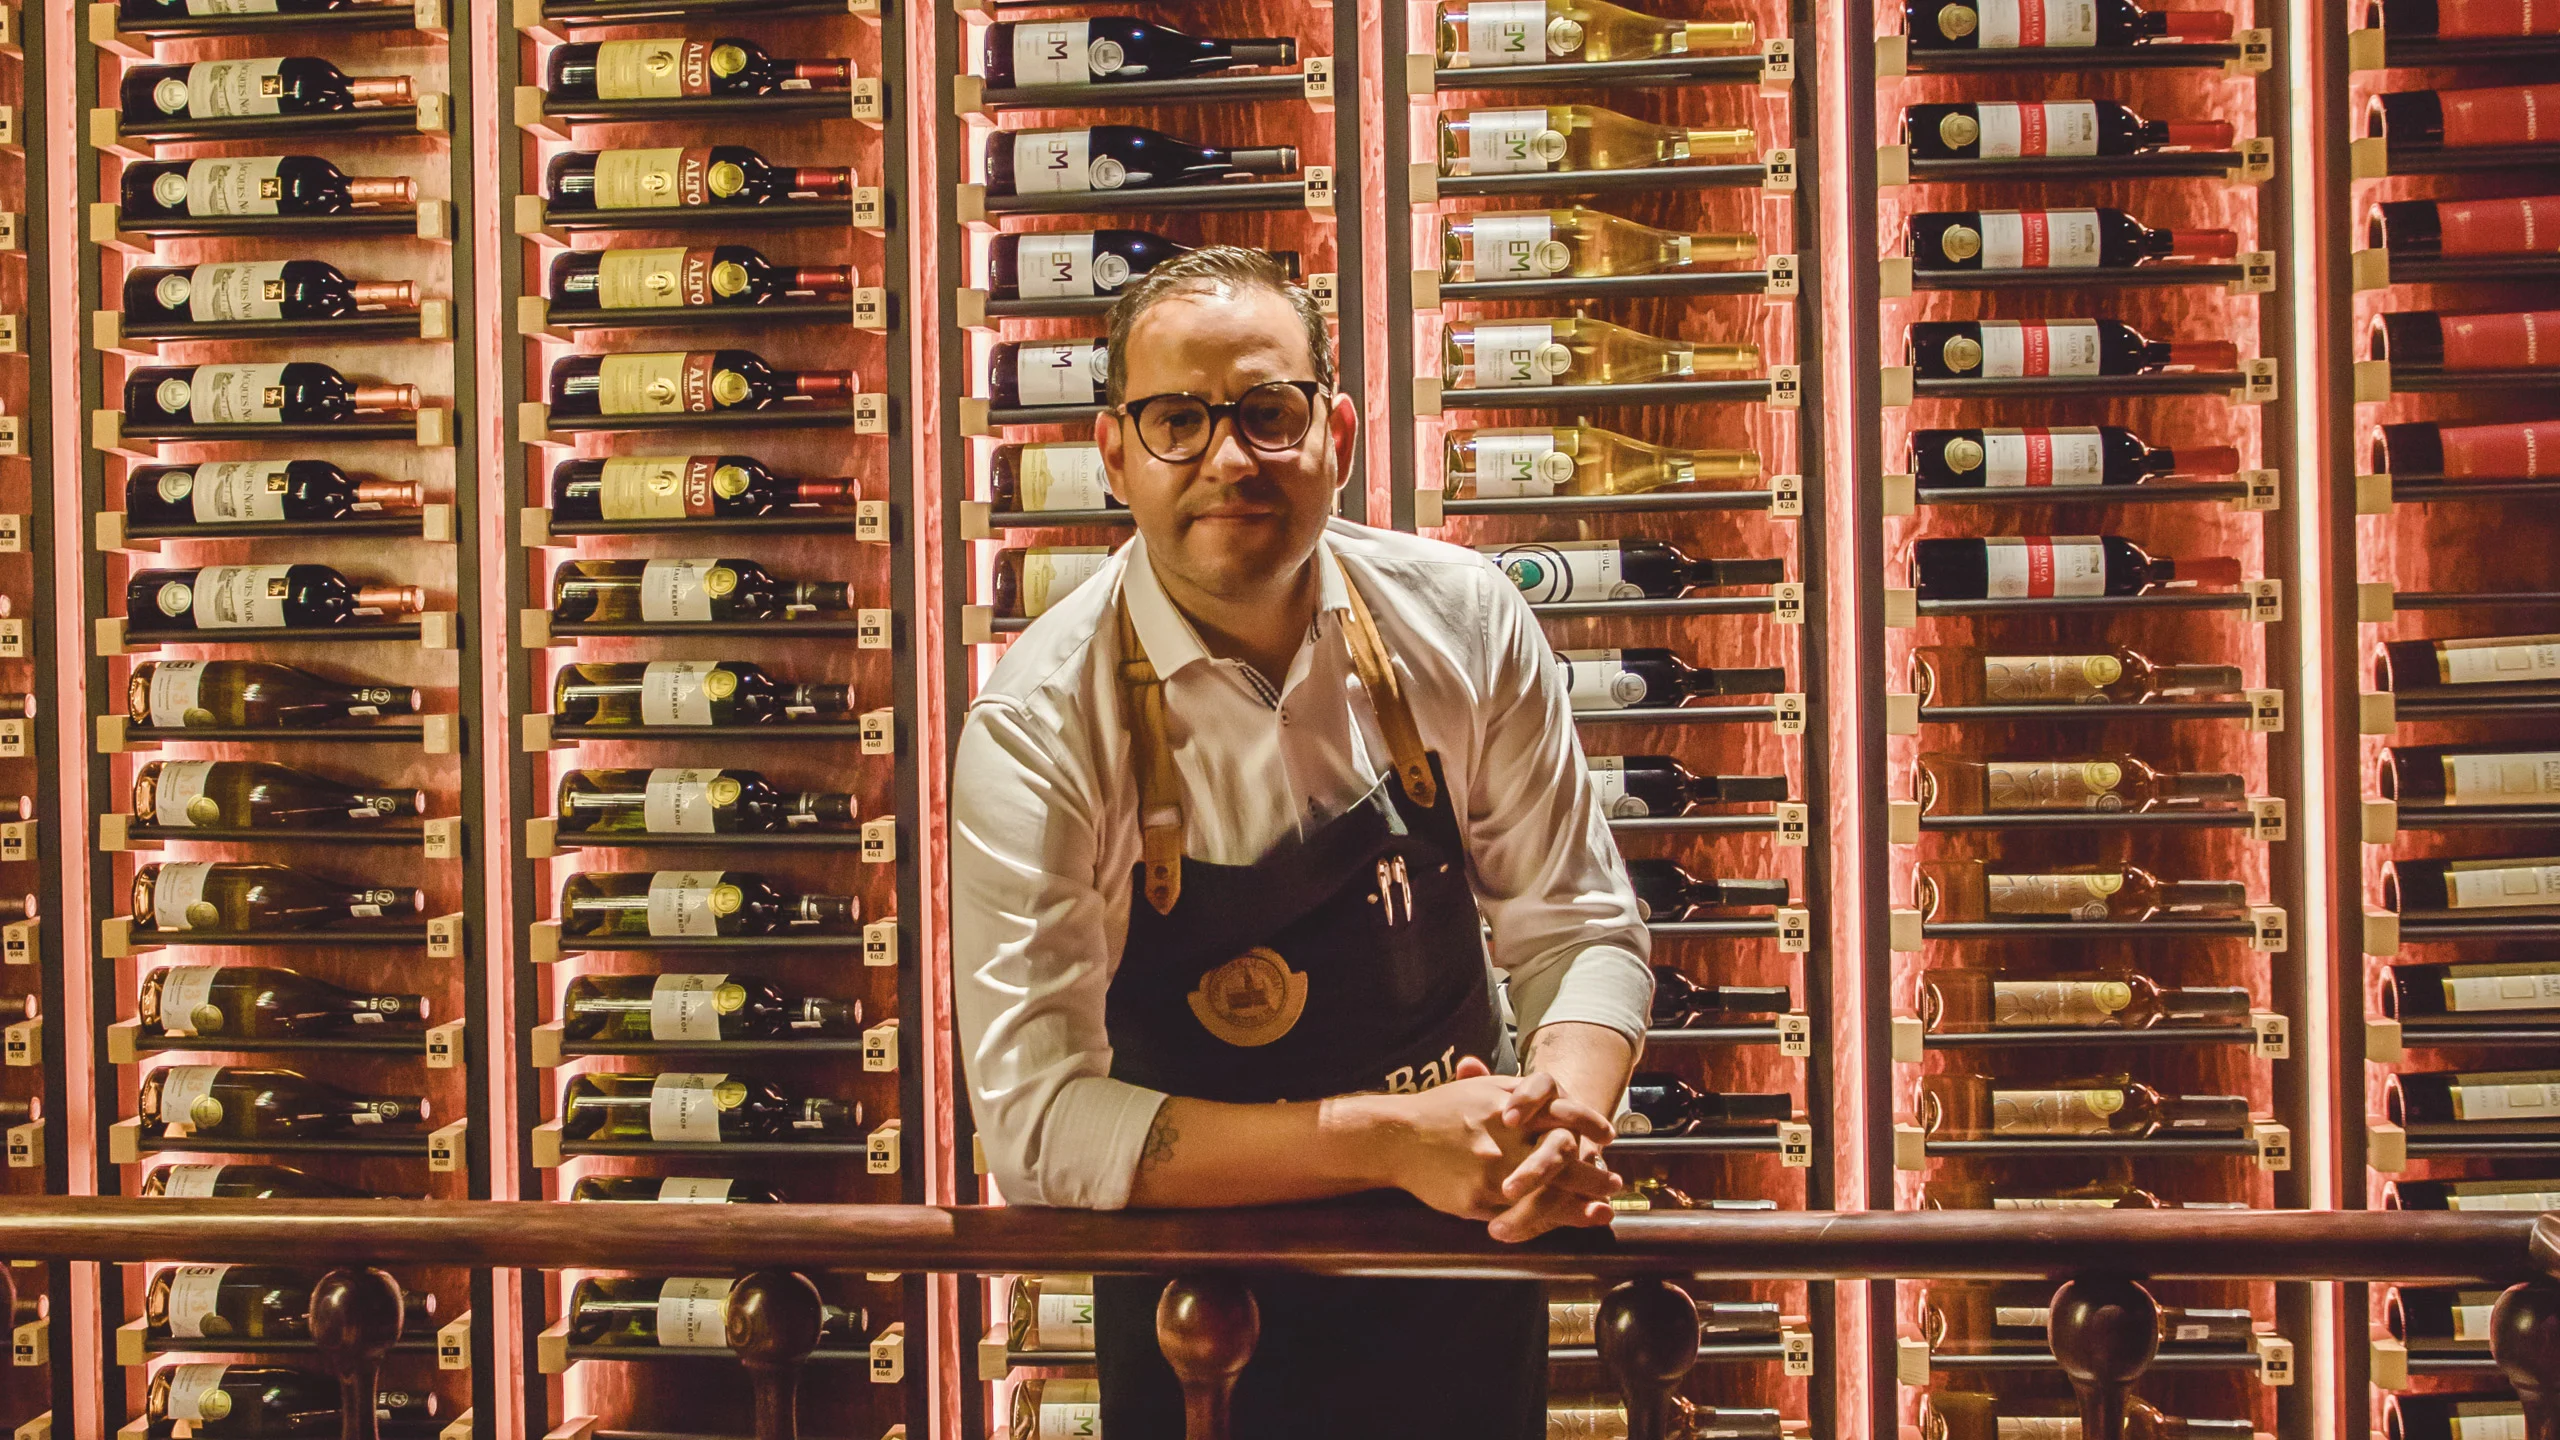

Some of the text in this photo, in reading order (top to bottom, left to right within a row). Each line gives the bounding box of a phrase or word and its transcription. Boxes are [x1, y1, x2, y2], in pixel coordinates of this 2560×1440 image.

[1504, 23, 1525, 52] EM
[1048, 31, 1068, 60] EM
[688, 43, 703, 88] ALTO
[1770, 64, 1787, 72] 422
[1308, 83, 1326, 91] 438
[856, 105, 872, 113] 454
[2031, 108, 2040, 151] TOURIGA
[1506, 131, 1526, 160] EM
[1048, 140, 1068, 169] EM
[686, 159, 701, 205] ALTO
[1773, 174, 1790, 183] 423
[1309, 191, 1326, 199] 439
[2034, 218, 2043, 262] TOURIGA
[1509, 240, 1530, 272] EM
[1052, 252, 1072, 282] EM
[689, 259, 704, 305] ALTO
[1774, 280, 1791, 288] 424
[857, 313, 874, 321] 456
[2034, 329, 2043, 373] TOURIGA
[1510, 350, 1531, 381] EM
[690, 367, 705, 411] ALTO
[1778, 391, 1795, 400] 425
[858, 419, 875, 427] 457
[2038, 439, 2046, 482] TOURIGA
[1511, 453, 1532, 481] EM
[691, 462, 707, 506] ALTO
[1778, 501, 1796, 509] 426
[859, 526, 876, 534] 458
[2039, 545, 2048, 582] OURIGA
[1780, 610, 1797, 618] 427
[862, 636, 879, 645] 459
[1, 644, 16, 652] 491
[1782, 721, 1799, 729] 428
[865, 740, 882, 748] 460
[1784, 832, 1802, 841] 429
[866, 850, 881, 858] 461
[677, 903, 685, 934] PERRON
[1785, 939, 1803, 947] 430
[868, 952, 885, 960] 462
[1786, 1043, 1803, 1051] 431
[868, 1058, 884, 1067] 463
[1385, 1045, 1455, 1094] Bar
[1788, 1154, 1804, 1163] 432
[872, 1161, 888, 1169] 464
[687, 1312, 695, 1343] PERRON
[1790, 1362, 1807, 1370] 434
[875, 1369, 891, 1377] 466
